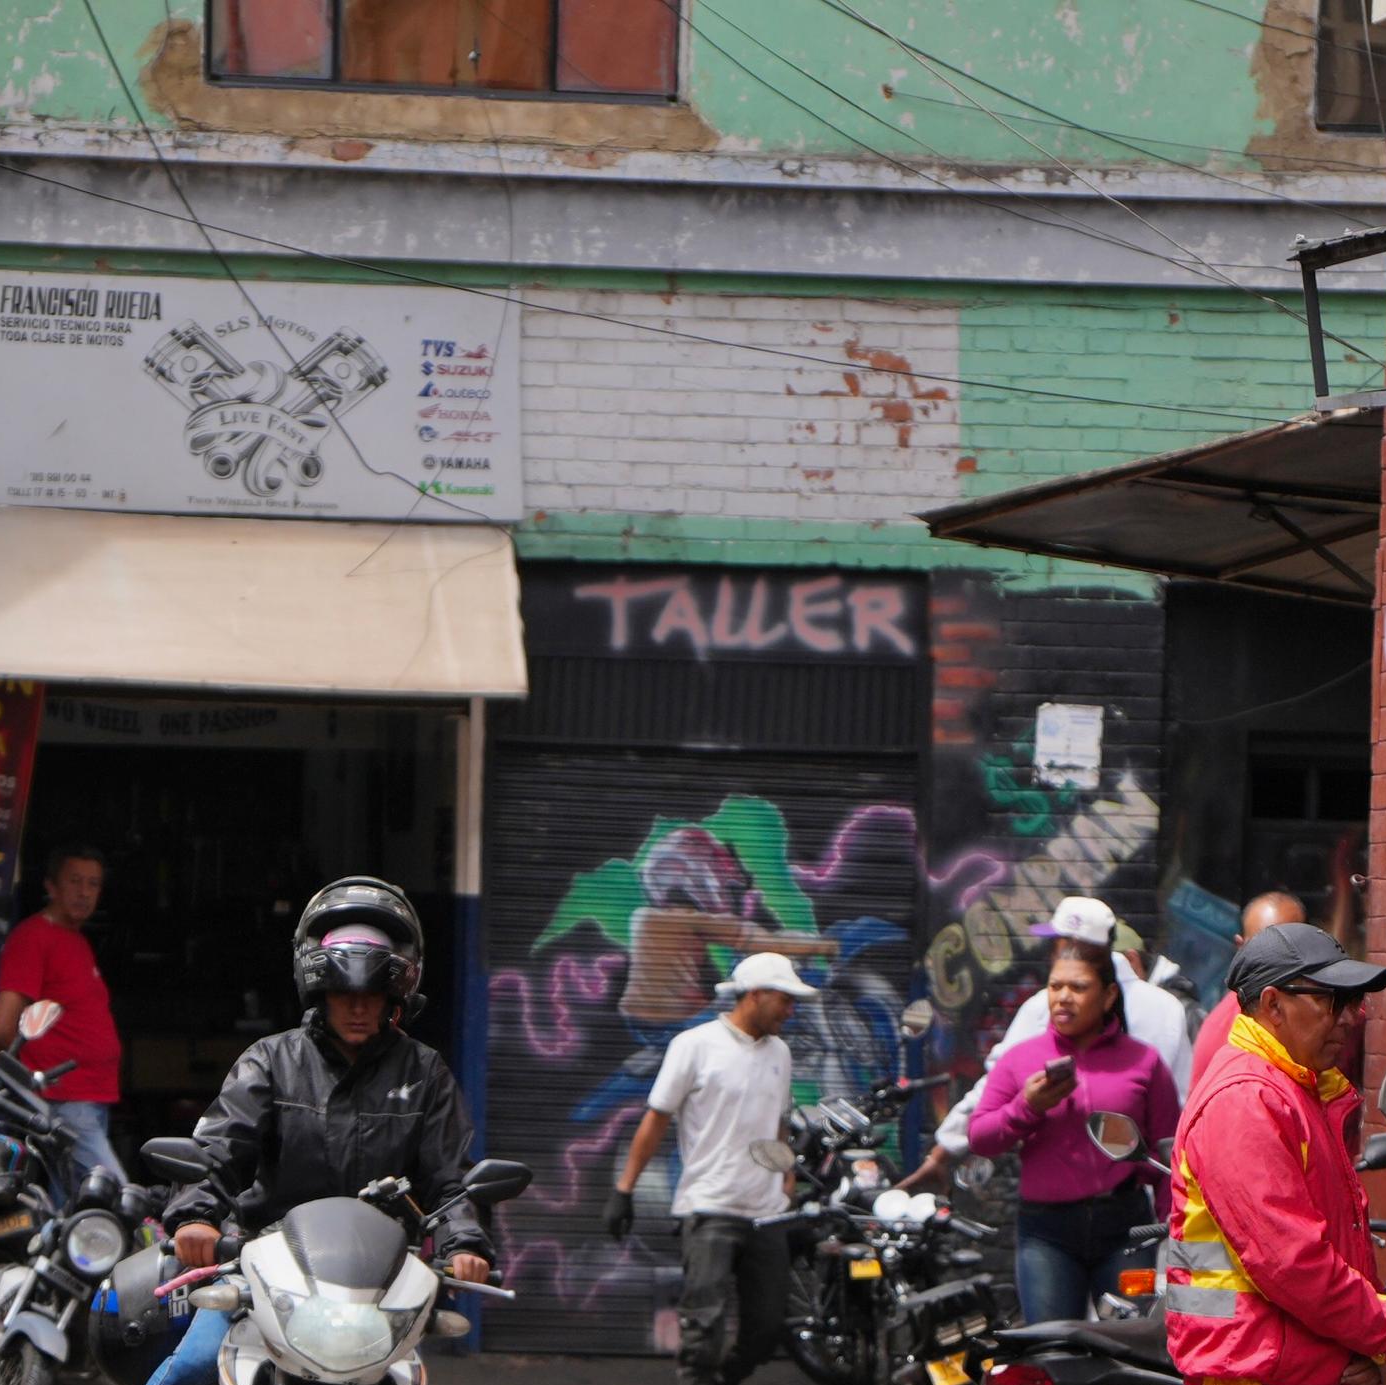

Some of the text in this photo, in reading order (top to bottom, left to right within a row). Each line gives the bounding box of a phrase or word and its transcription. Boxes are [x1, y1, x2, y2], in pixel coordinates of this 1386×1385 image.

[0, 285, 162, 320] FRANCISCO RUEDA
[0, 317, 132, 333] SERVICIO TECNICO PARA
[0, 330, 124, 347] TODA CLASE DE MOTOS
[421, 339, 456, 357] TVS
[437, 364, 494, 376] SUZUKI
[439, 457, 491, 470] YAMAHA
[575, 574, 914, 657] TALLER
